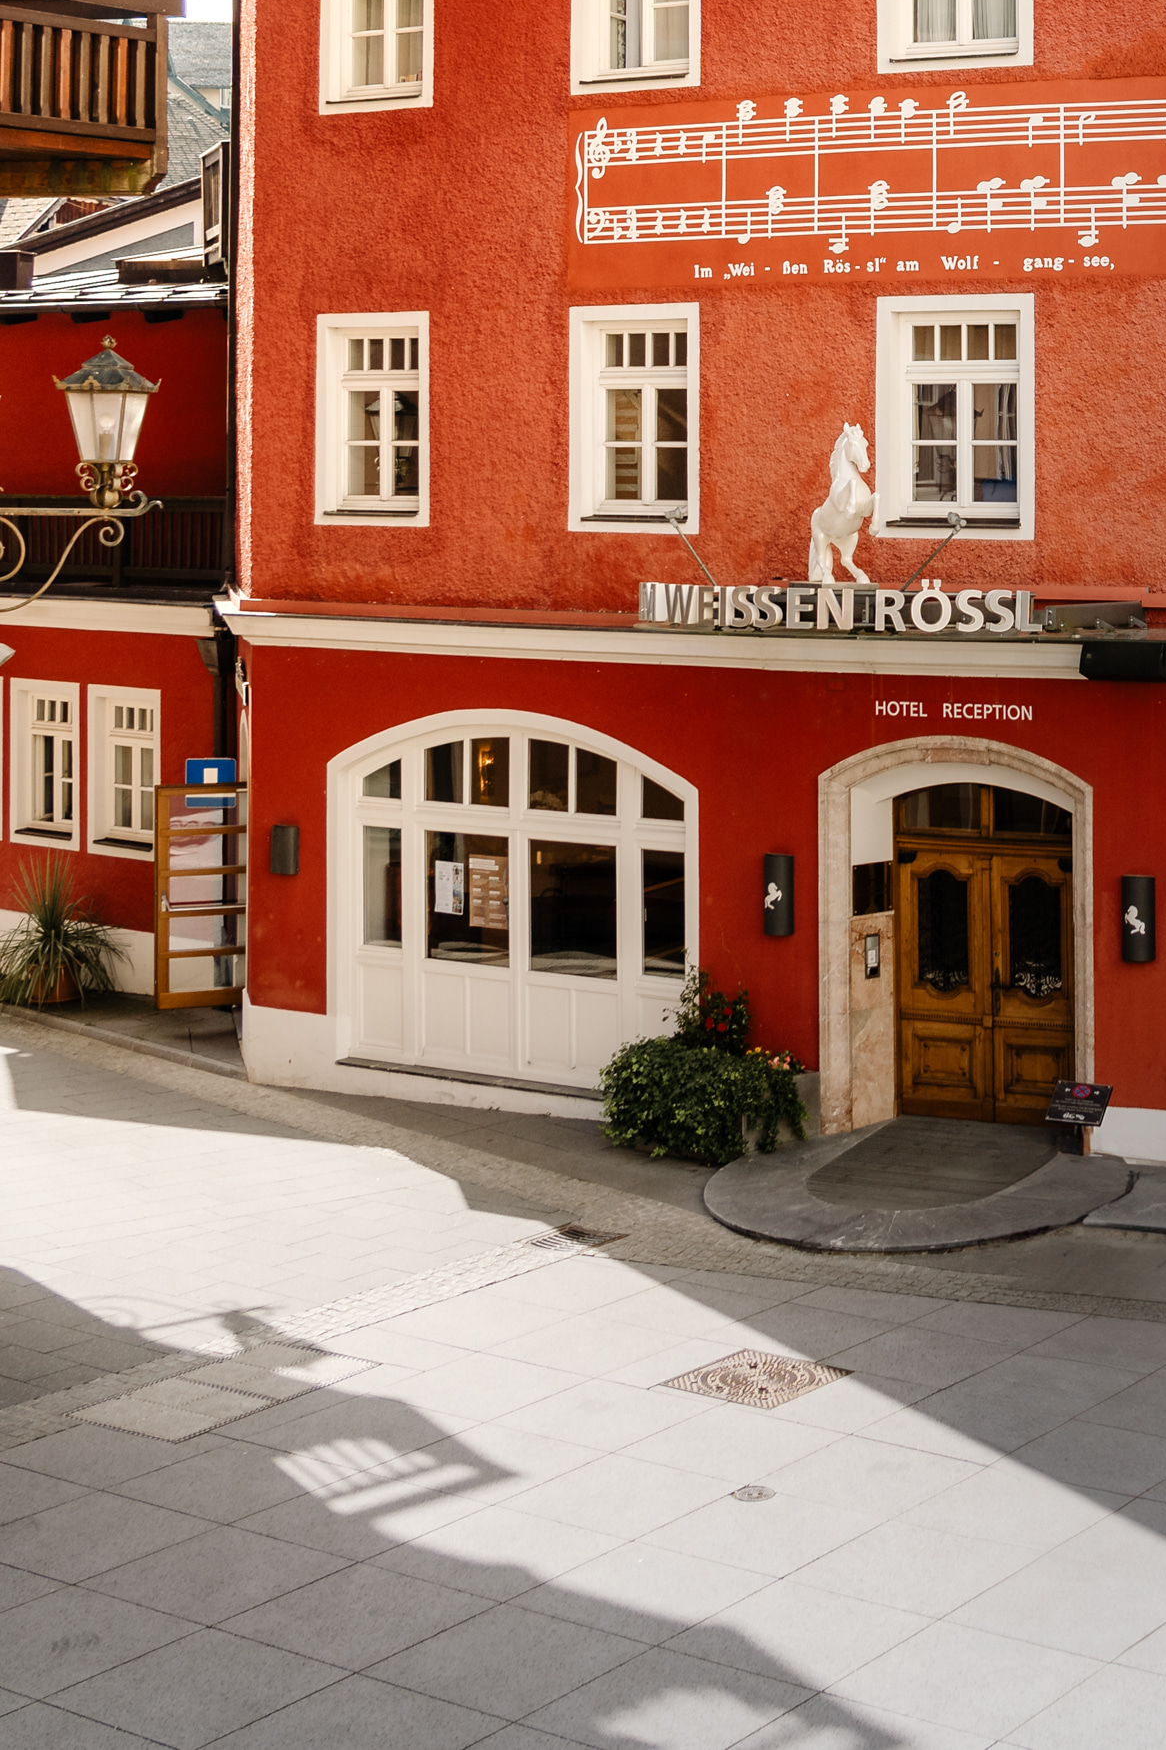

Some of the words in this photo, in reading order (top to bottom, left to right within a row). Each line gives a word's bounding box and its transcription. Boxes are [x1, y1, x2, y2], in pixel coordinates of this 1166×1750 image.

[693, 264, 713, 279] Im
[782, 260, 809, 275] ßen
[895, 260, 920, 272] am
[940, 254, 980, 271] Wolf
[1082, 255, 1115, 271] see,
[664, 583, 854, 631] WEISSEN
[874, 579, 1043, 633] RÖSSL
[875, 700, 928, 717] HOTEL
[943, 702, 1033, 721] RECEPTION
